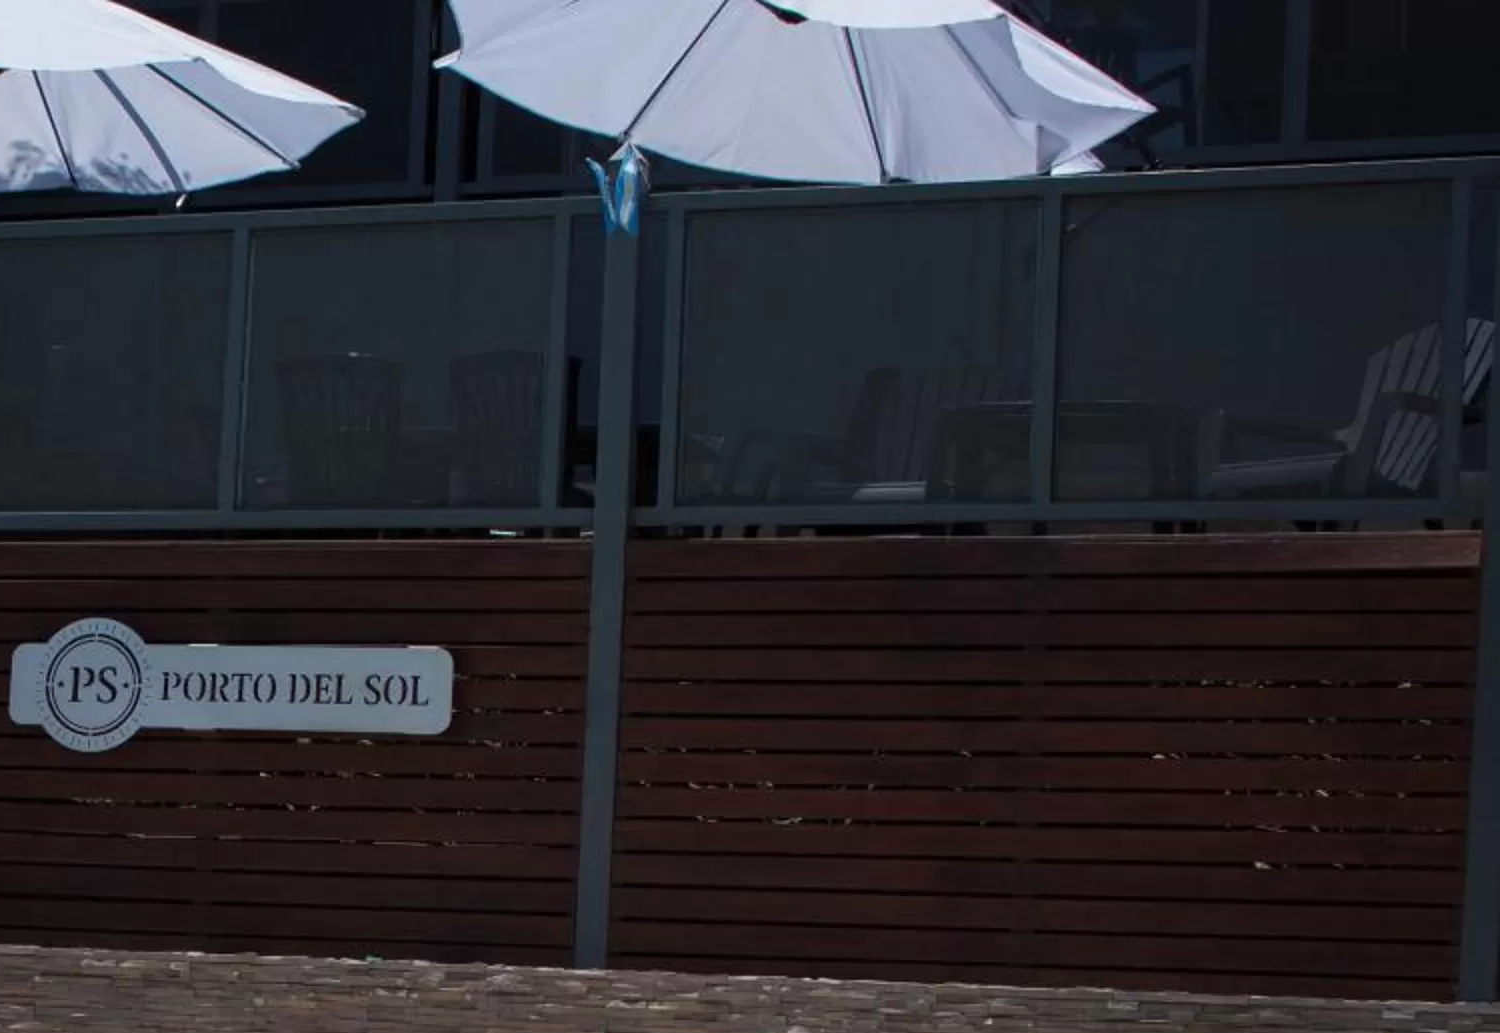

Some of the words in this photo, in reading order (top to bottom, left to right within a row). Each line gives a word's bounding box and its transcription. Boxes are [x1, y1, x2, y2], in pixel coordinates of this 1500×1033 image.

[161, 671, 277, 703] PORTO
[287, 672, 353, 705] DEL
[363, 674, 429, 707] SOL
